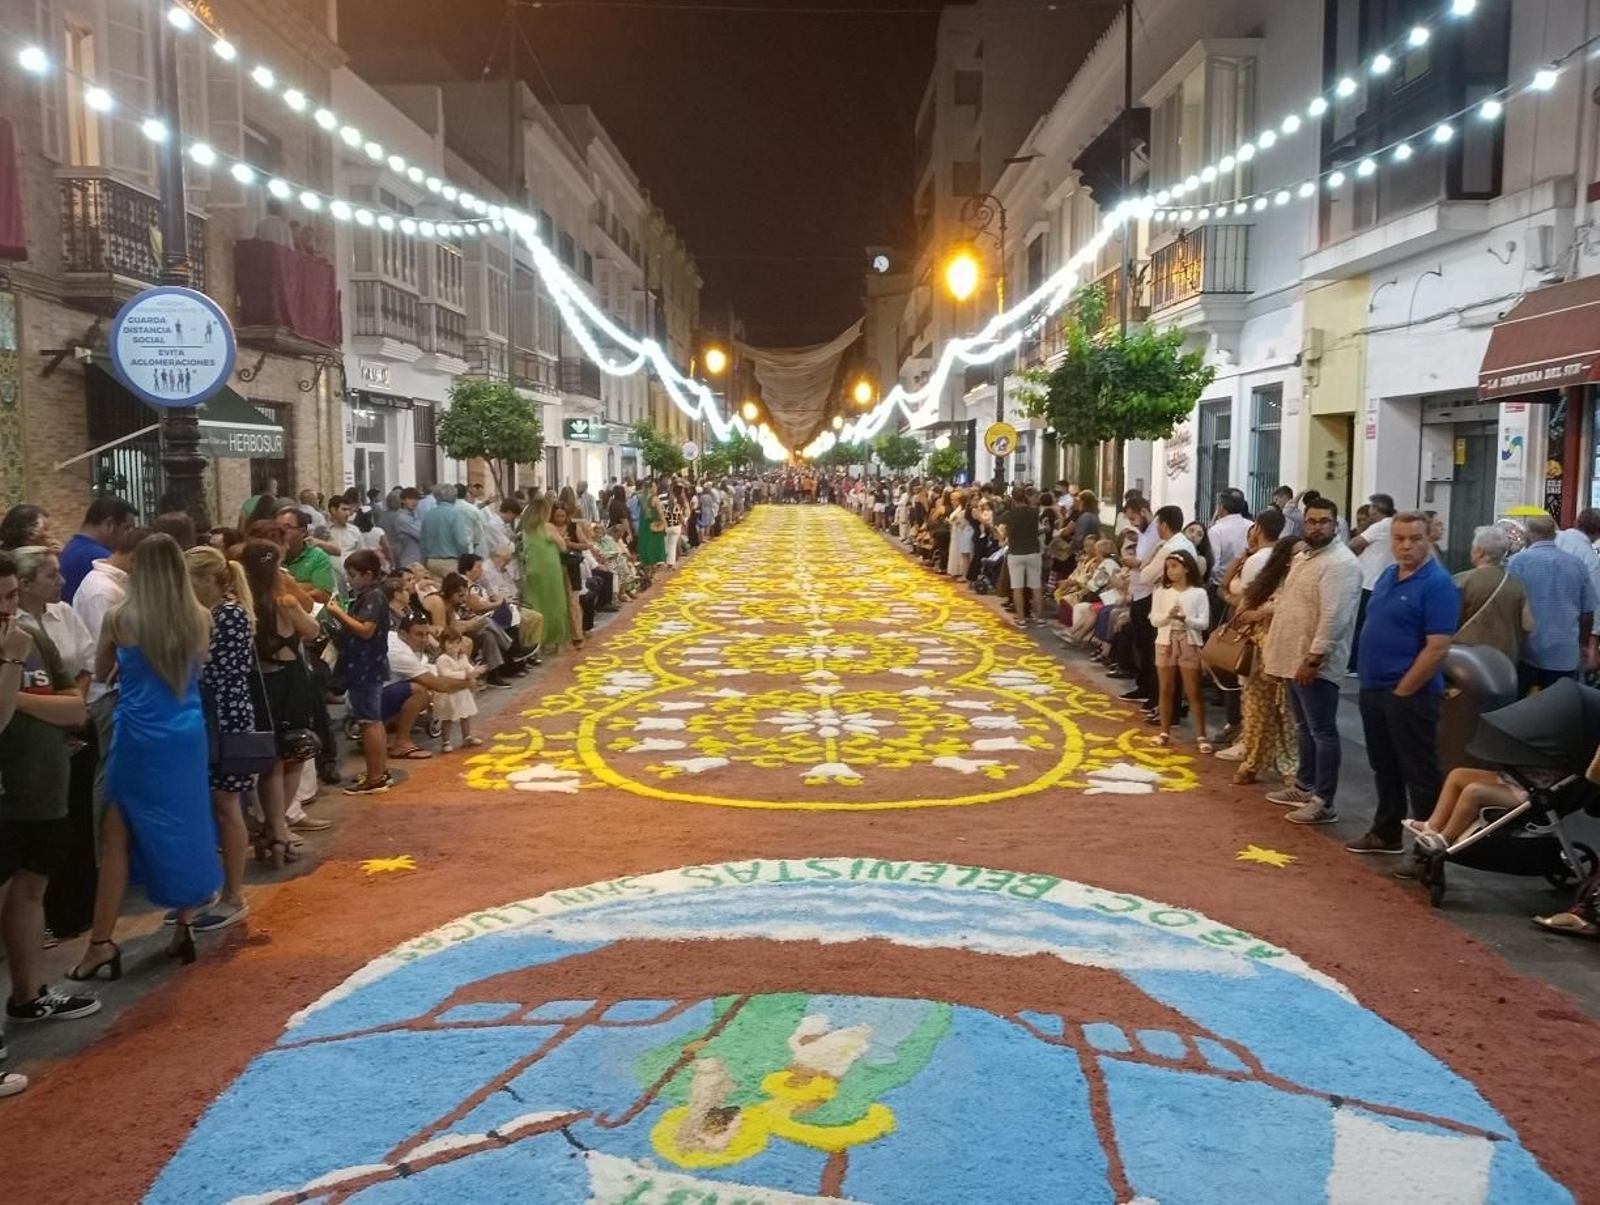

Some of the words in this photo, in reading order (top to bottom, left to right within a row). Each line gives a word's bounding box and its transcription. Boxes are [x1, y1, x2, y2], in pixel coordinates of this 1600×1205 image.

[127, 316, 166, 324] GUARDA
[123, 326, 172, 334] DISTANCIA
[132, 336, 166, 344] SOCIAL
[158, 349, 185, 357] EVITA
[130, 358, 216, 367] AGLOMERACIONES
[229, 433, 282, 452] HERBOSUR
[679, 858, 1061, 901] BELENISTAS
[550, 876, 657, 908] SAN
